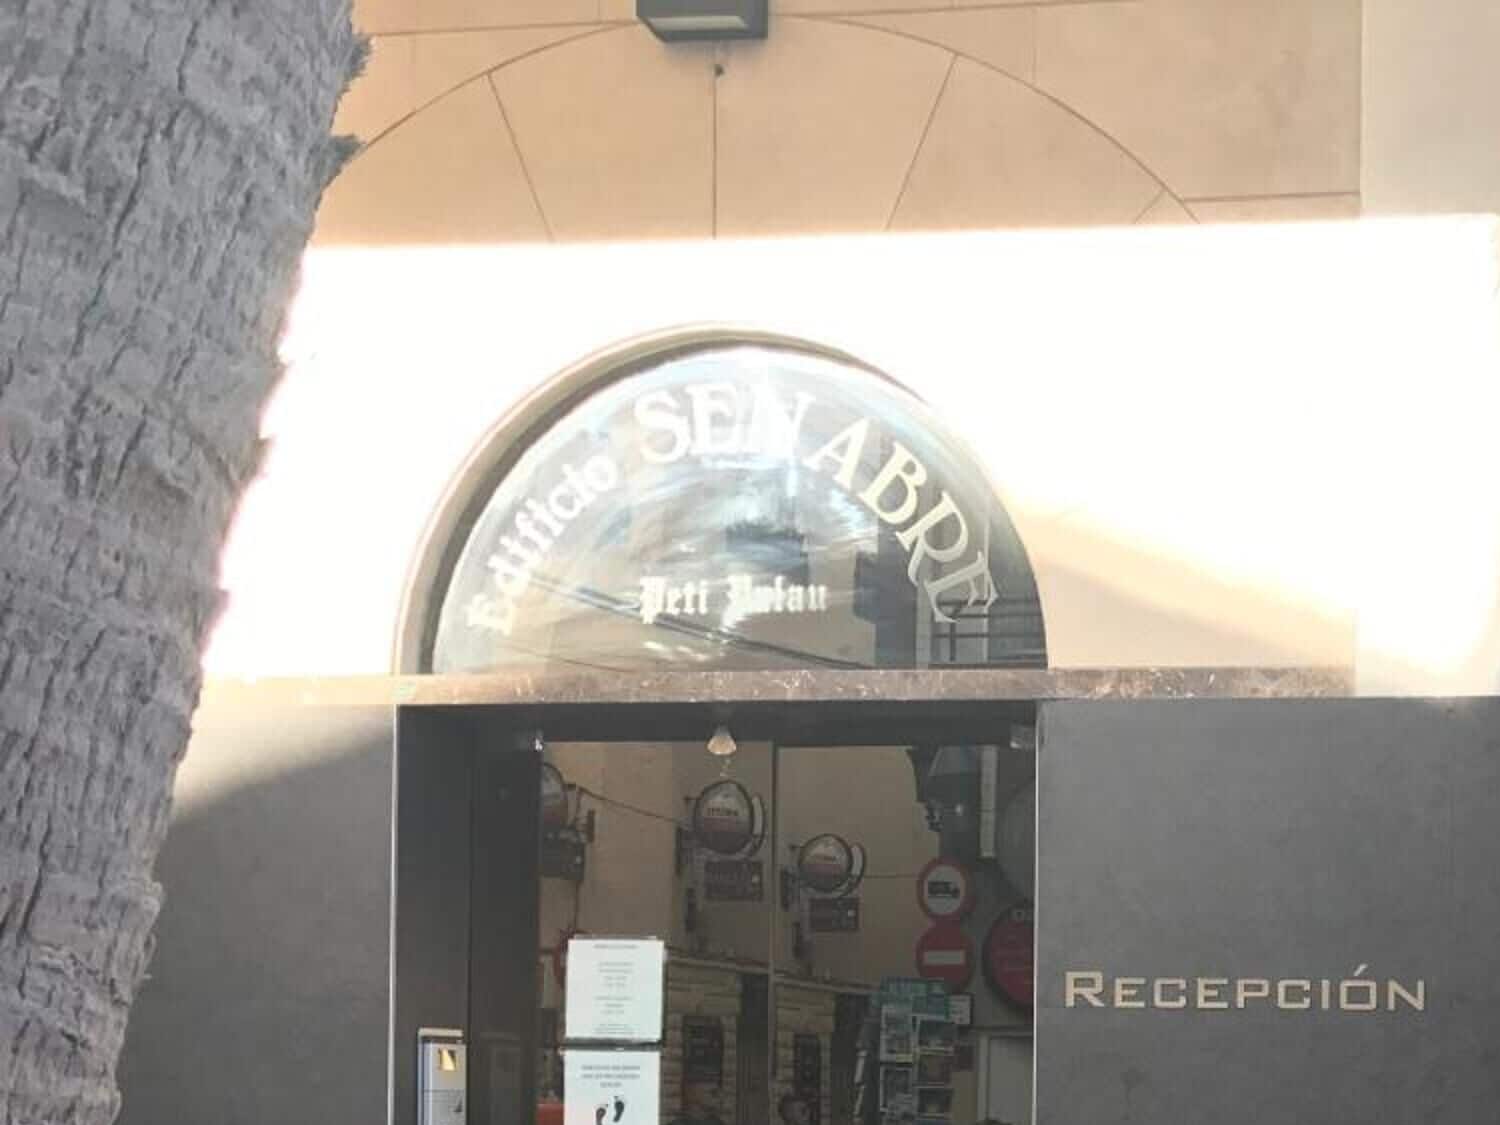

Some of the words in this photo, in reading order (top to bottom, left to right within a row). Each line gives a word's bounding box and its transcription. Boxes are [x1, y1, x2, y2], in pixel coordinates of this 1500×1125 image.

[464, 455, 618, 636] Edificio
[634, 382, 999, 623] SENABRE
[1064, 963, 1426, 1011] RECEPCIÓN
